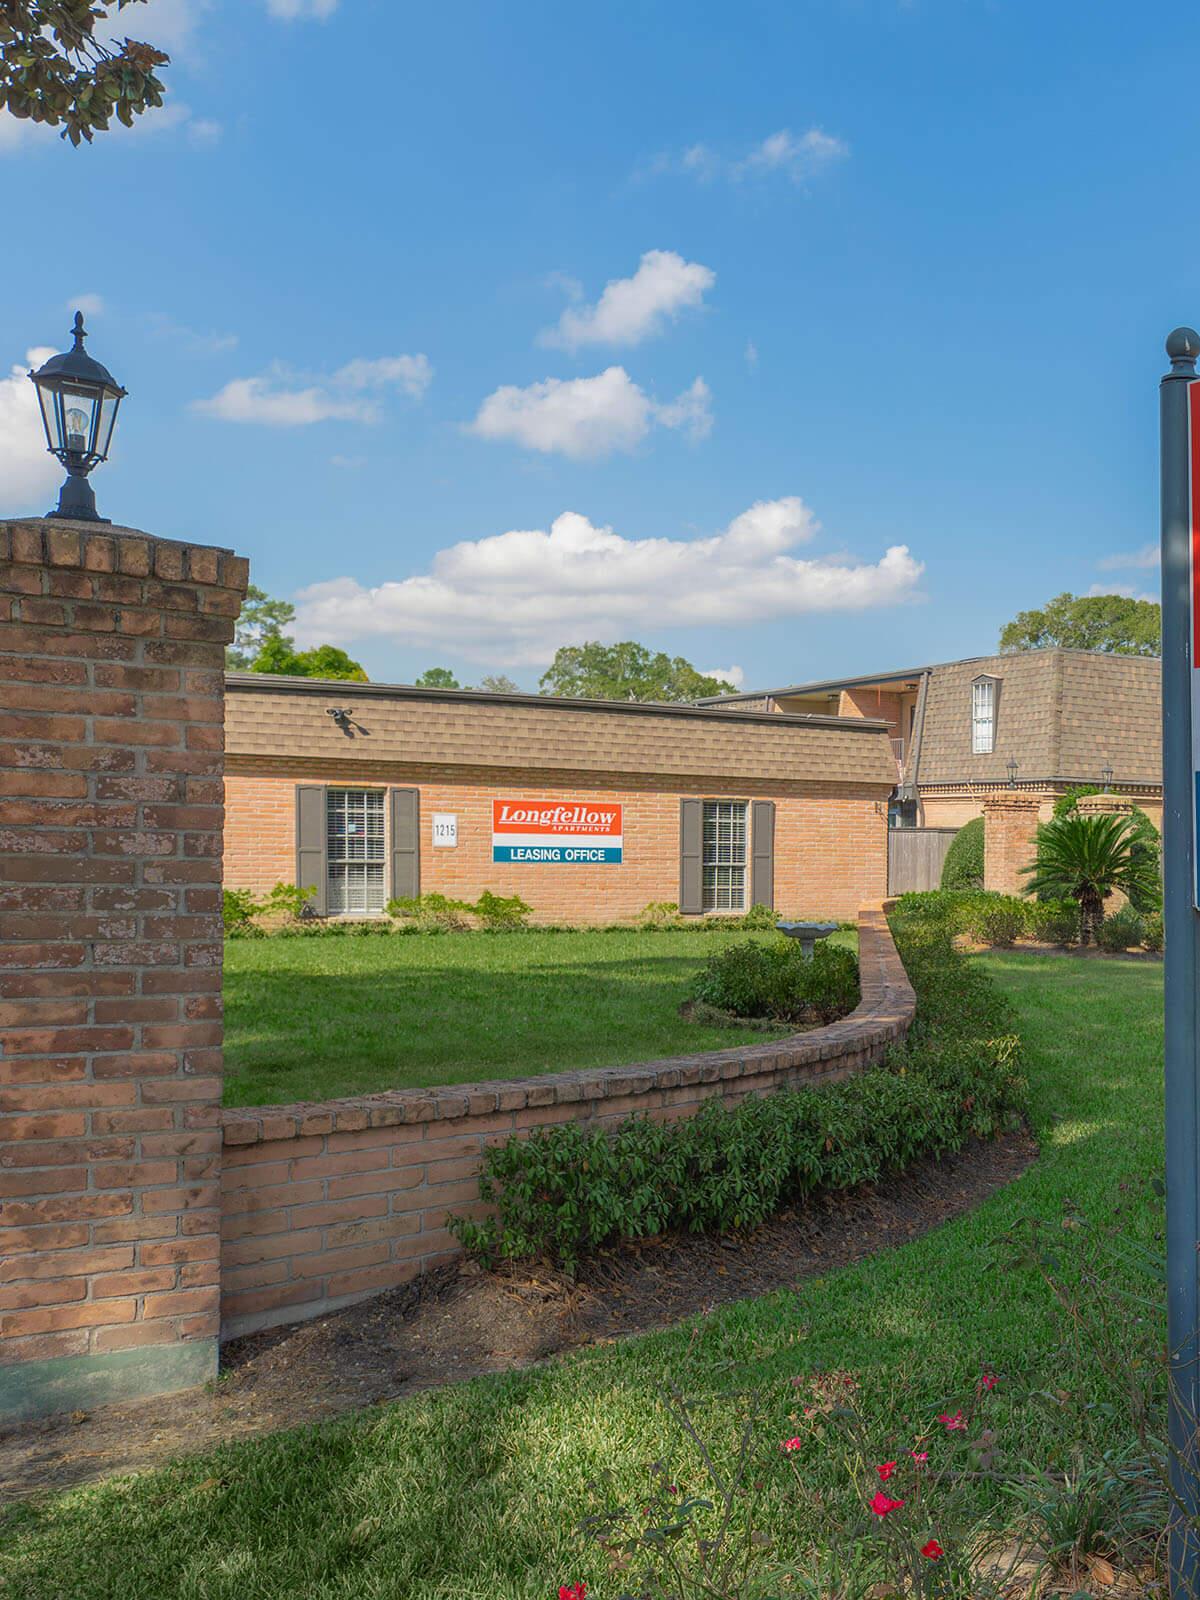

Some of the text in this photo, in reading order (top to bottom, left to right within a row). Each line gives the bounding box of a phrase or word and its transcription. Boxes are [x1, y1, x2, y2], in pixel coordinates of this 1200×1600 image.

[499, 806, 616, 826] Longfellow
[435, 824, 455, 836] 1215
[510, 848, 605, 861] LEASING OFFICE
